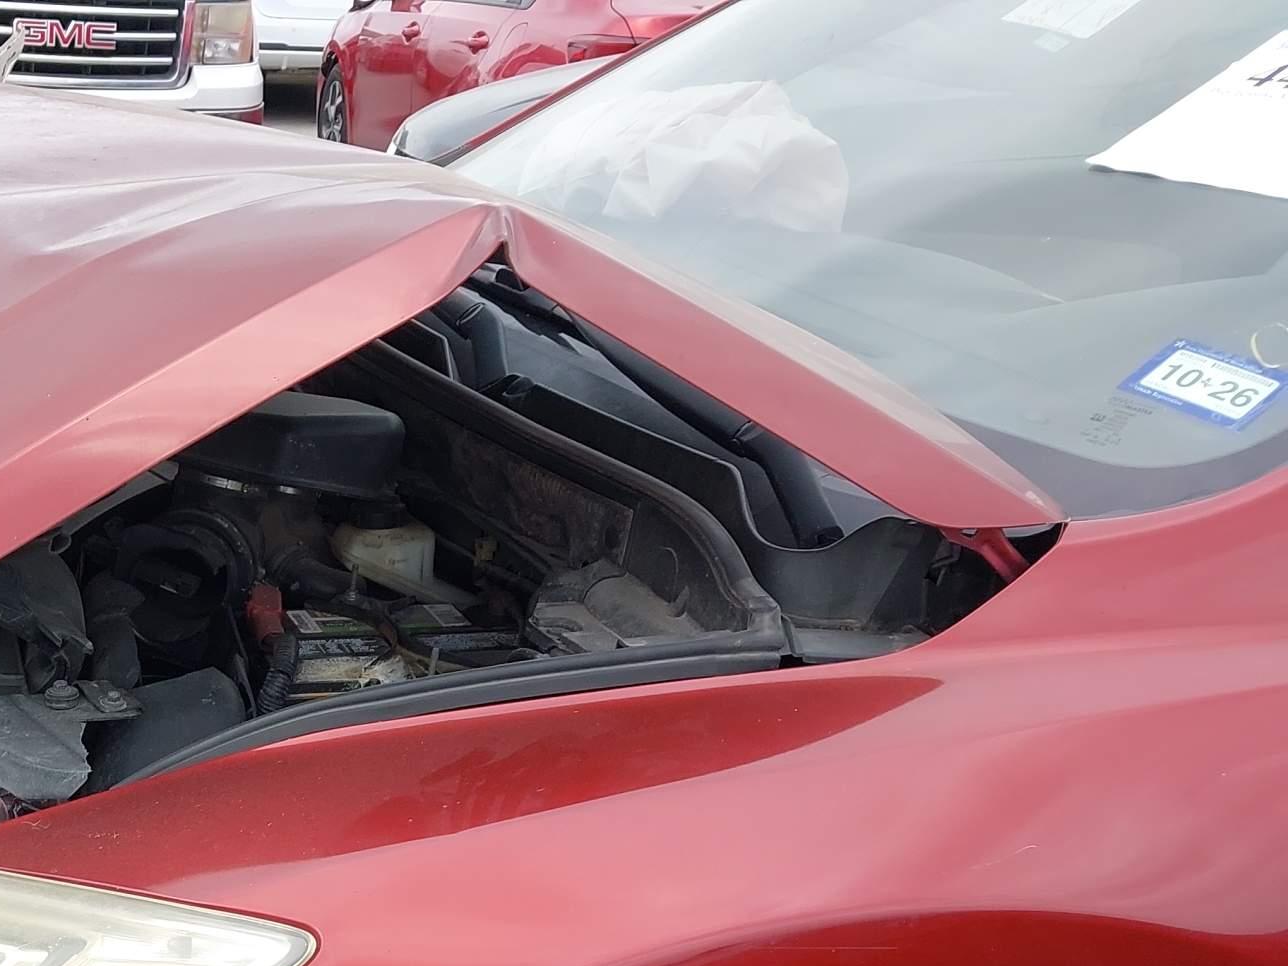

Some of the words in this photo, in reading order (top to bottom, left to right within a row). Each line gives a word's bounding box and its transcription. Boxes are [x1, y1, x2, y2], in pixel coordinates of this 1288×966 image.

[14, 18, 117, 50] GMC
[1161, 363, 1204, 388] 10
[1207, 380, 1261, 407] 26
